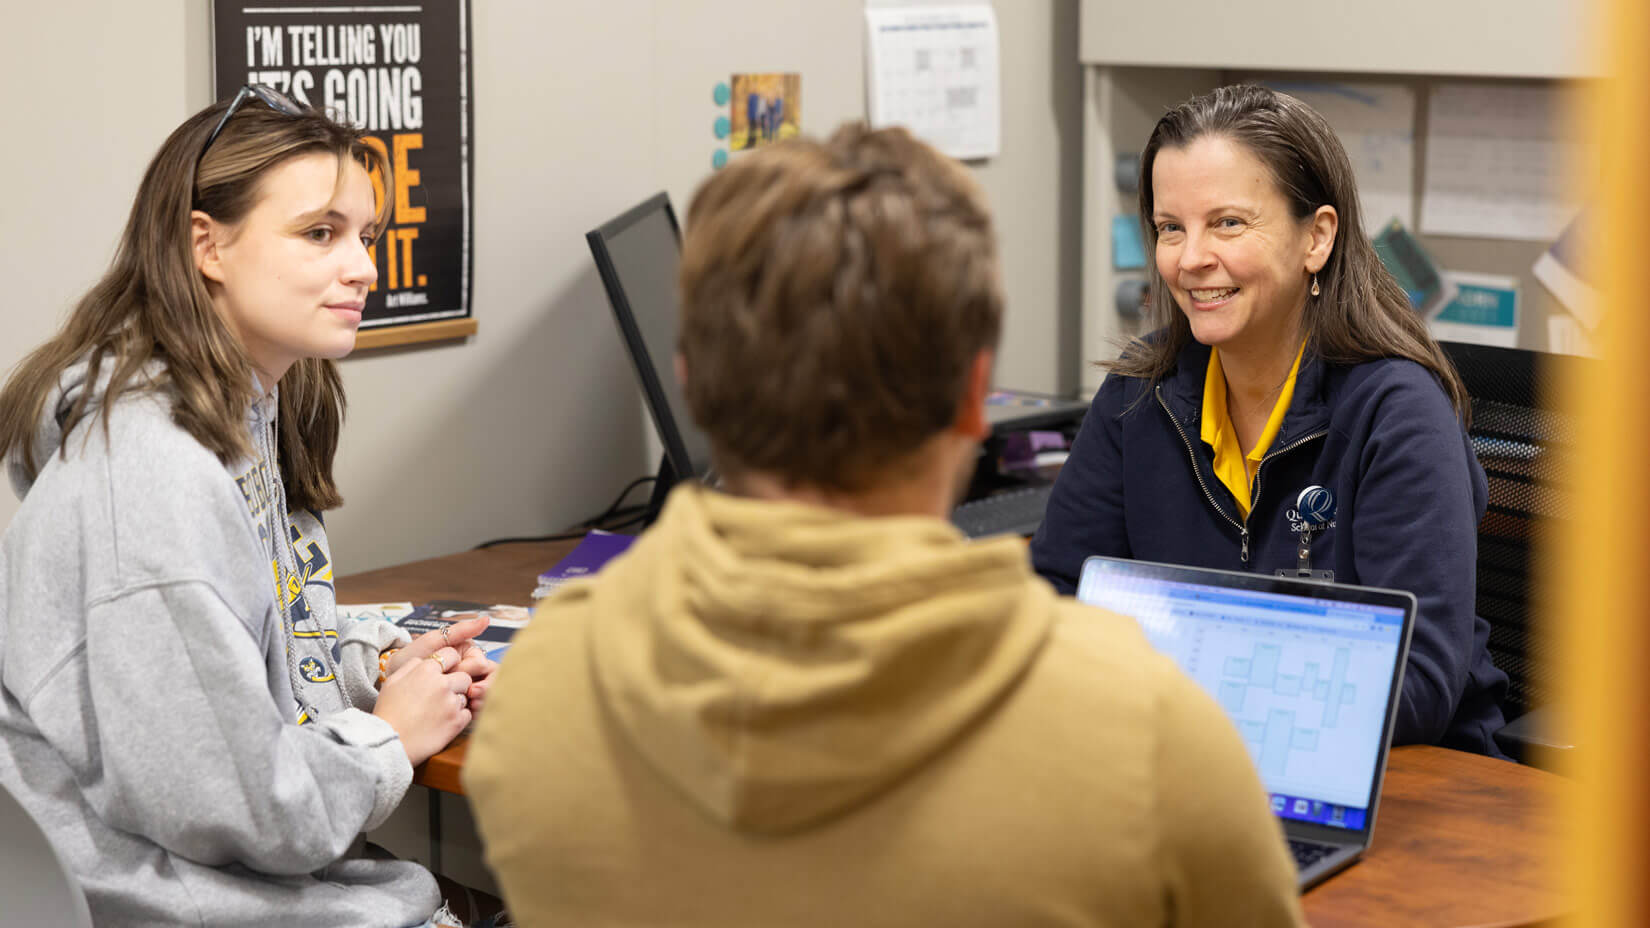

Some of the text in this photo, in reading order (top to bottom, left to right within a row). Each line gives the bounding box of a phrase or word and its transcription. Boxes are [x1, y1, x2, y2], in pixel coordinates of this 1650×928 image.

[247, 24, 421, 67] I'M TELLING YOU
[248, 67, 423, 130] 'S GOING
[387, 228, 428, 289] IT.
